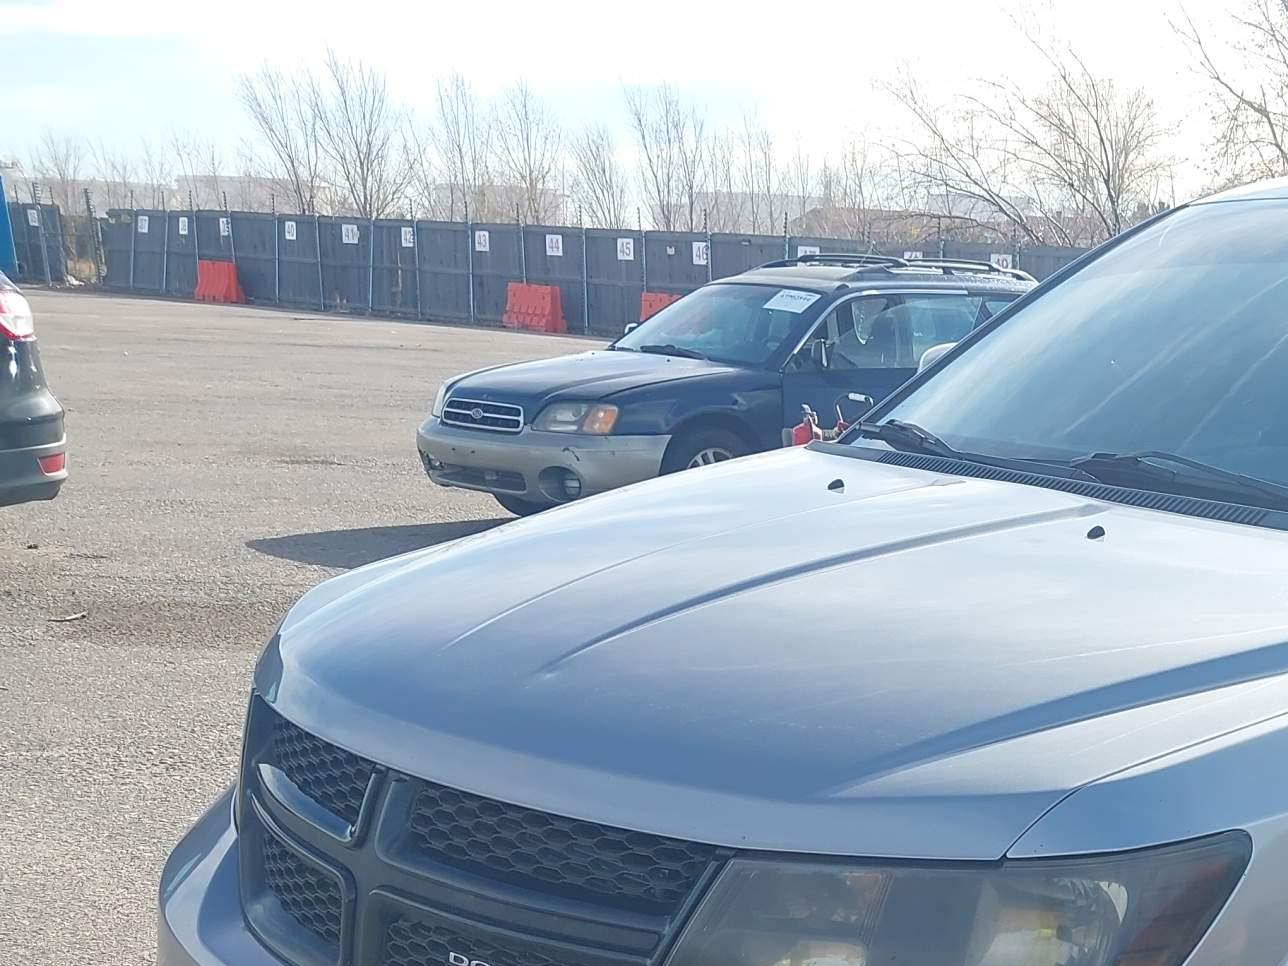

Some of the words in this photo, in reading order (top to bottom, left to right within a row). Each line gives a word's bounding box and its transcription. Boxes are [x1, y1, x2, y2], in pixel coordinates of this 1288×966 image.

[477, 233, 488, 247] 43
[548, 238, 560, 252] 44
[619, 241, 631, 257] 45
